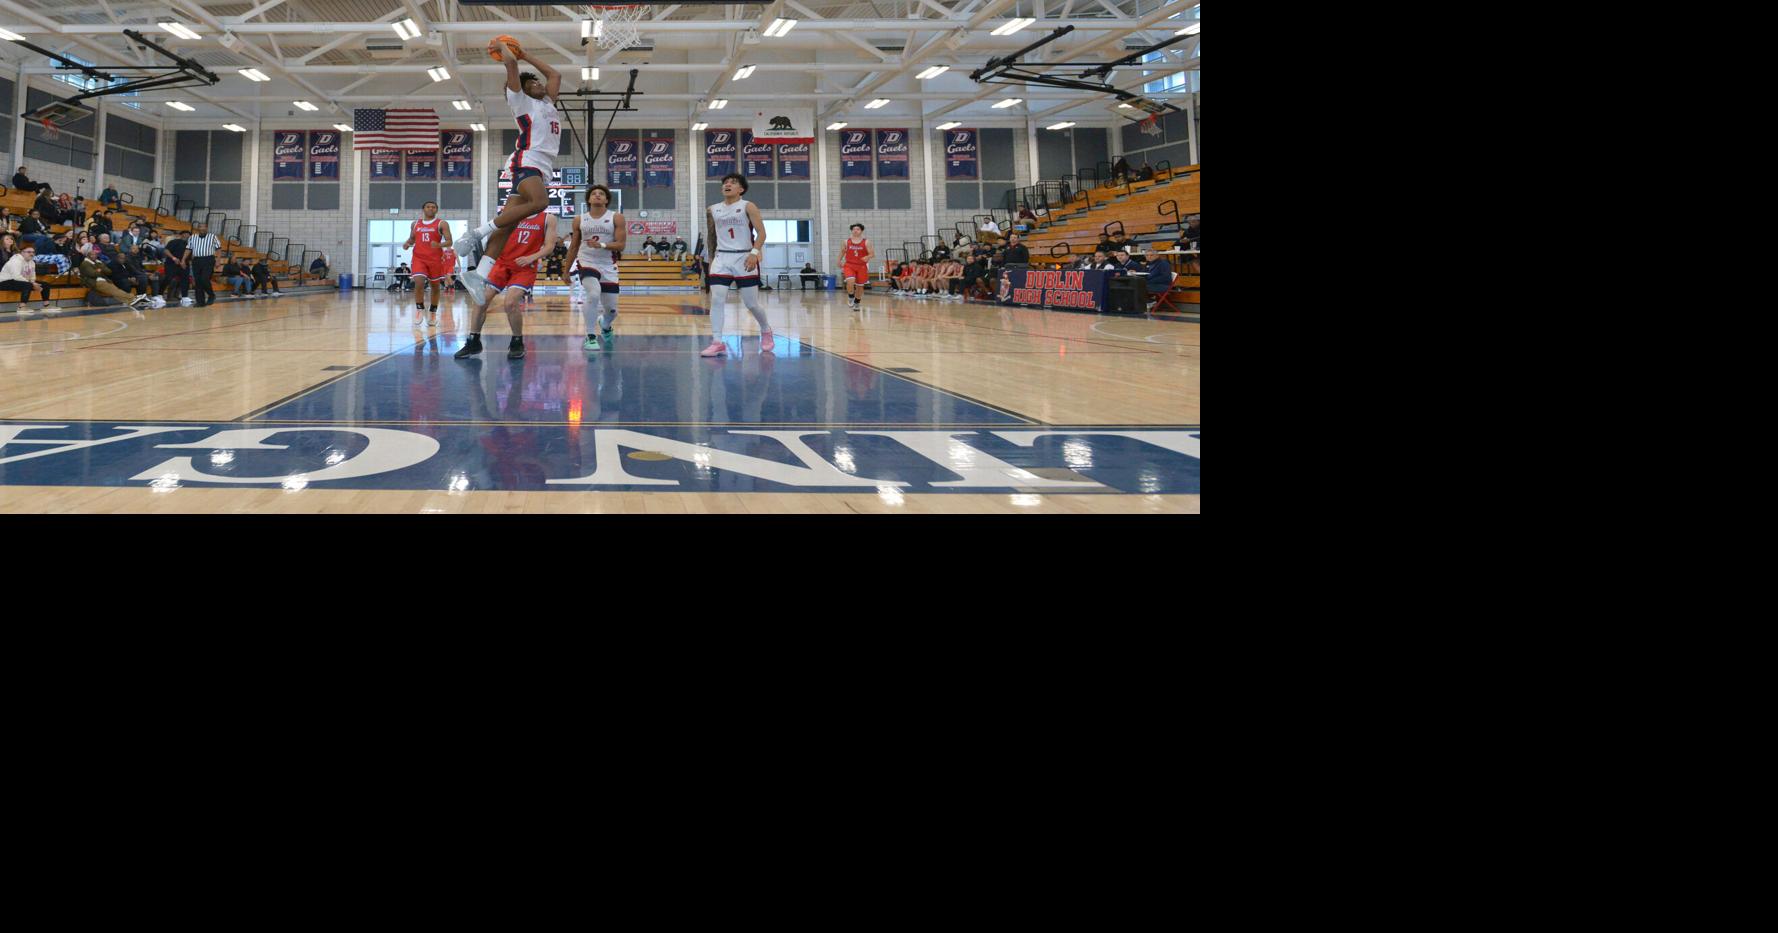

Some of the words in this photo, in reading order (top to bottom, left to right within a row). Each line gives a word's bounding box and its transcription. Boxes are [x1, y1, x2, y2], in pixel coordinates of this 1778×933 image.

[550, 121, 560, 135] 15
[275, 144, 303, 155] Gaels
[311, 144, 339, 155] Gaels
[443, 144, 471, 155] Gaels
[707, 144, 736, 154] Gaels
[743, 144, 772, 154] Gaels
[779, 144, 808, 154] Gaels
[842, 144, 870, 154] Gaels
[878, 144, 907, 154] Gaels
[947, 144, 976, 153] Gaels
[608, 153, 637, 164] Gaels
[645, 153, 673, 164] Gaels
[548, 188, 566, 198] 20
[422, 232, 430, 242] 13
[517, 231, 530, 244] 12
[728, 227, 735, 239] 1
[1025, 270, 1085, 290] DUBLIN
[1013, 288, 1042, 304] HIGH
[1044, 290, 1096, 308] SCHOOL
